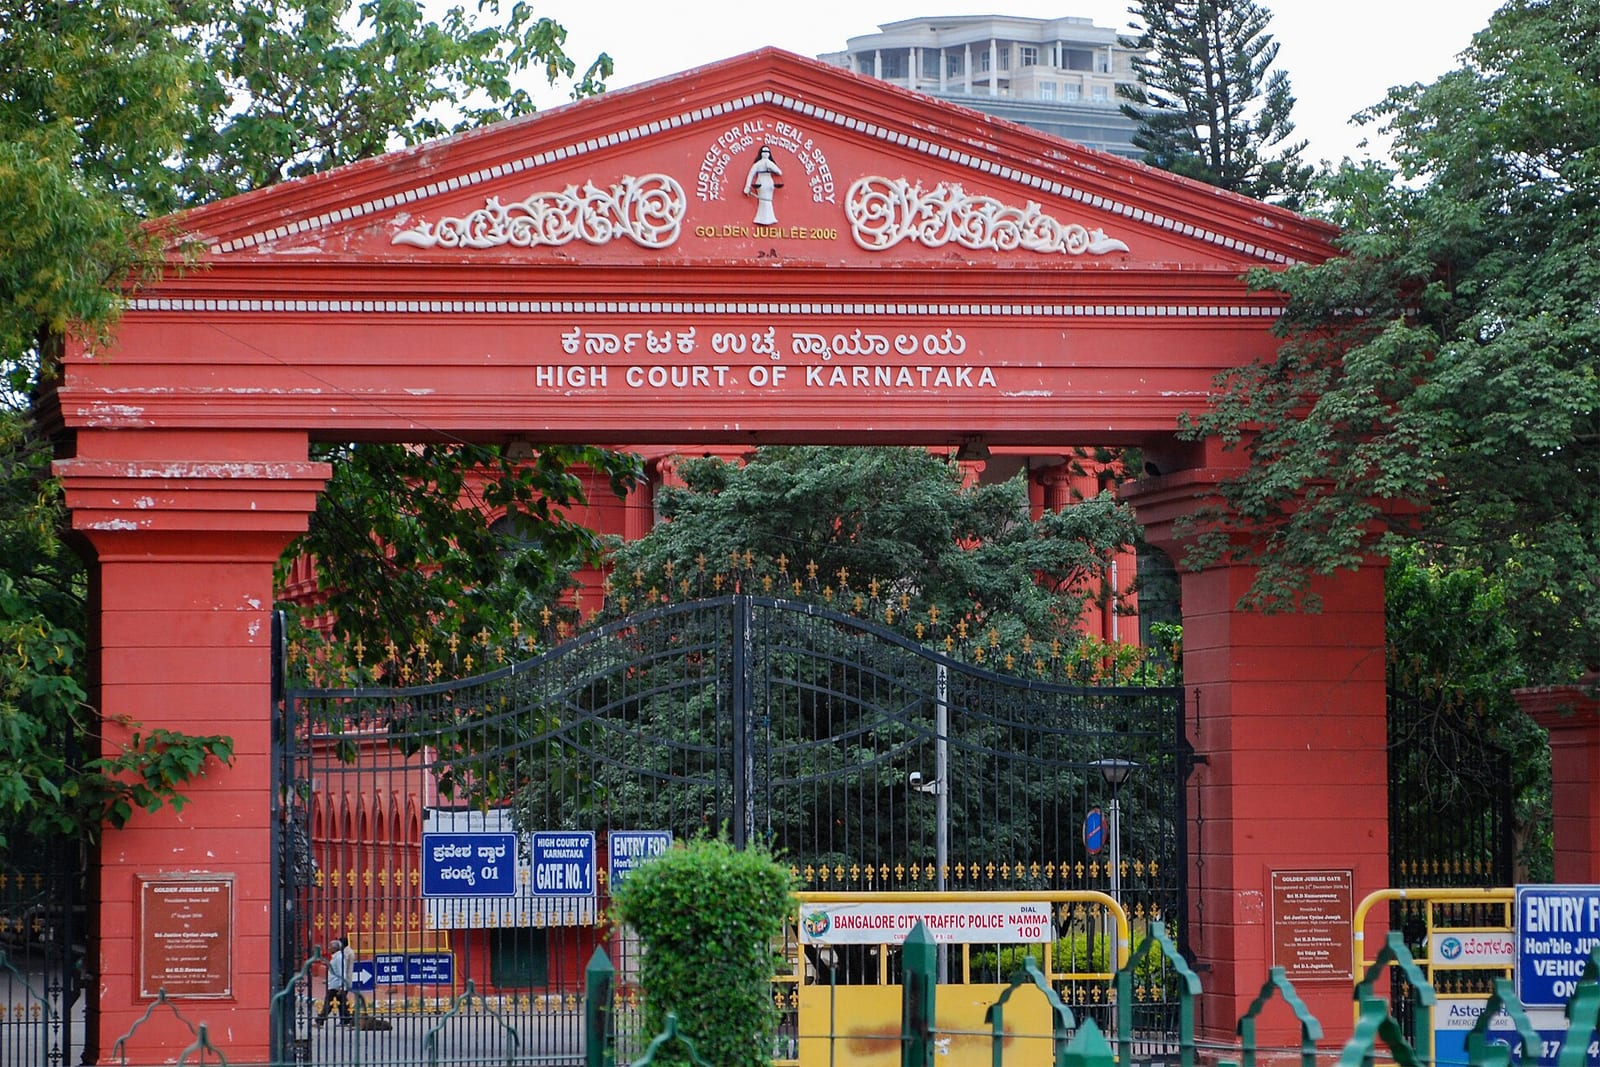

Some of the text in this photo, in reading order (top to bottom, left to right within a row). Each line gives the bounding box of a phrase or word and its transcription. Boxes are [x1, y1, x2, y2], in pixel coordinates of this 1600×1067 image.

[696, 144, 721, 201] JUSTICE
[718, 126, 742, 148] FOR
[743, 120, 764, 134] ALL
[775, 121, 804, 145] REAL
[804, 139, 814, 151] &
[812, 149, 835, 204] SPEEDY
[695, 225, 837, 240] GOLDEN JUBILEE 2006
[561, 326, 966, 360] ಕರ್ನಾಟಕ ಉಚ್ಚ ನ್ಯಾಯಾಲಯ
[535, 366, 998, 388] HIGH COURT OF KARNATAKA
[537, 838, 590, 848] HIGH COURT OF
[614, 837, 667, 856] ENTRY FOR
[433, 843, 506, 864] ಪ್ರವೇಶ ದ್ವಾರ
[543, 848, 584, 859] KARNATAKA
[440, 865, 498, 886] ಸಂಖ್ಯೆ 01
[537, 864, 591, 890] GATE NO. 1
[834, 914, 1004, 929] BANGALORE CITY TRAFFIC POLICE
[1008, 915, 1048, 925] NAMMA
[1526, 896, 1584, 933] ENTRY
[1017, 926, 1041, 938] 100
[1464, 938, 1515, 954] ಬೆಂಗಳೂ
[1525, 938, 1572, 955] Hon'ble
[1533, 959, 1586, 976] VEHIC
[1553, 981, 1578, 998] ON
[1450, 1004, 1485, 1017] Aster
